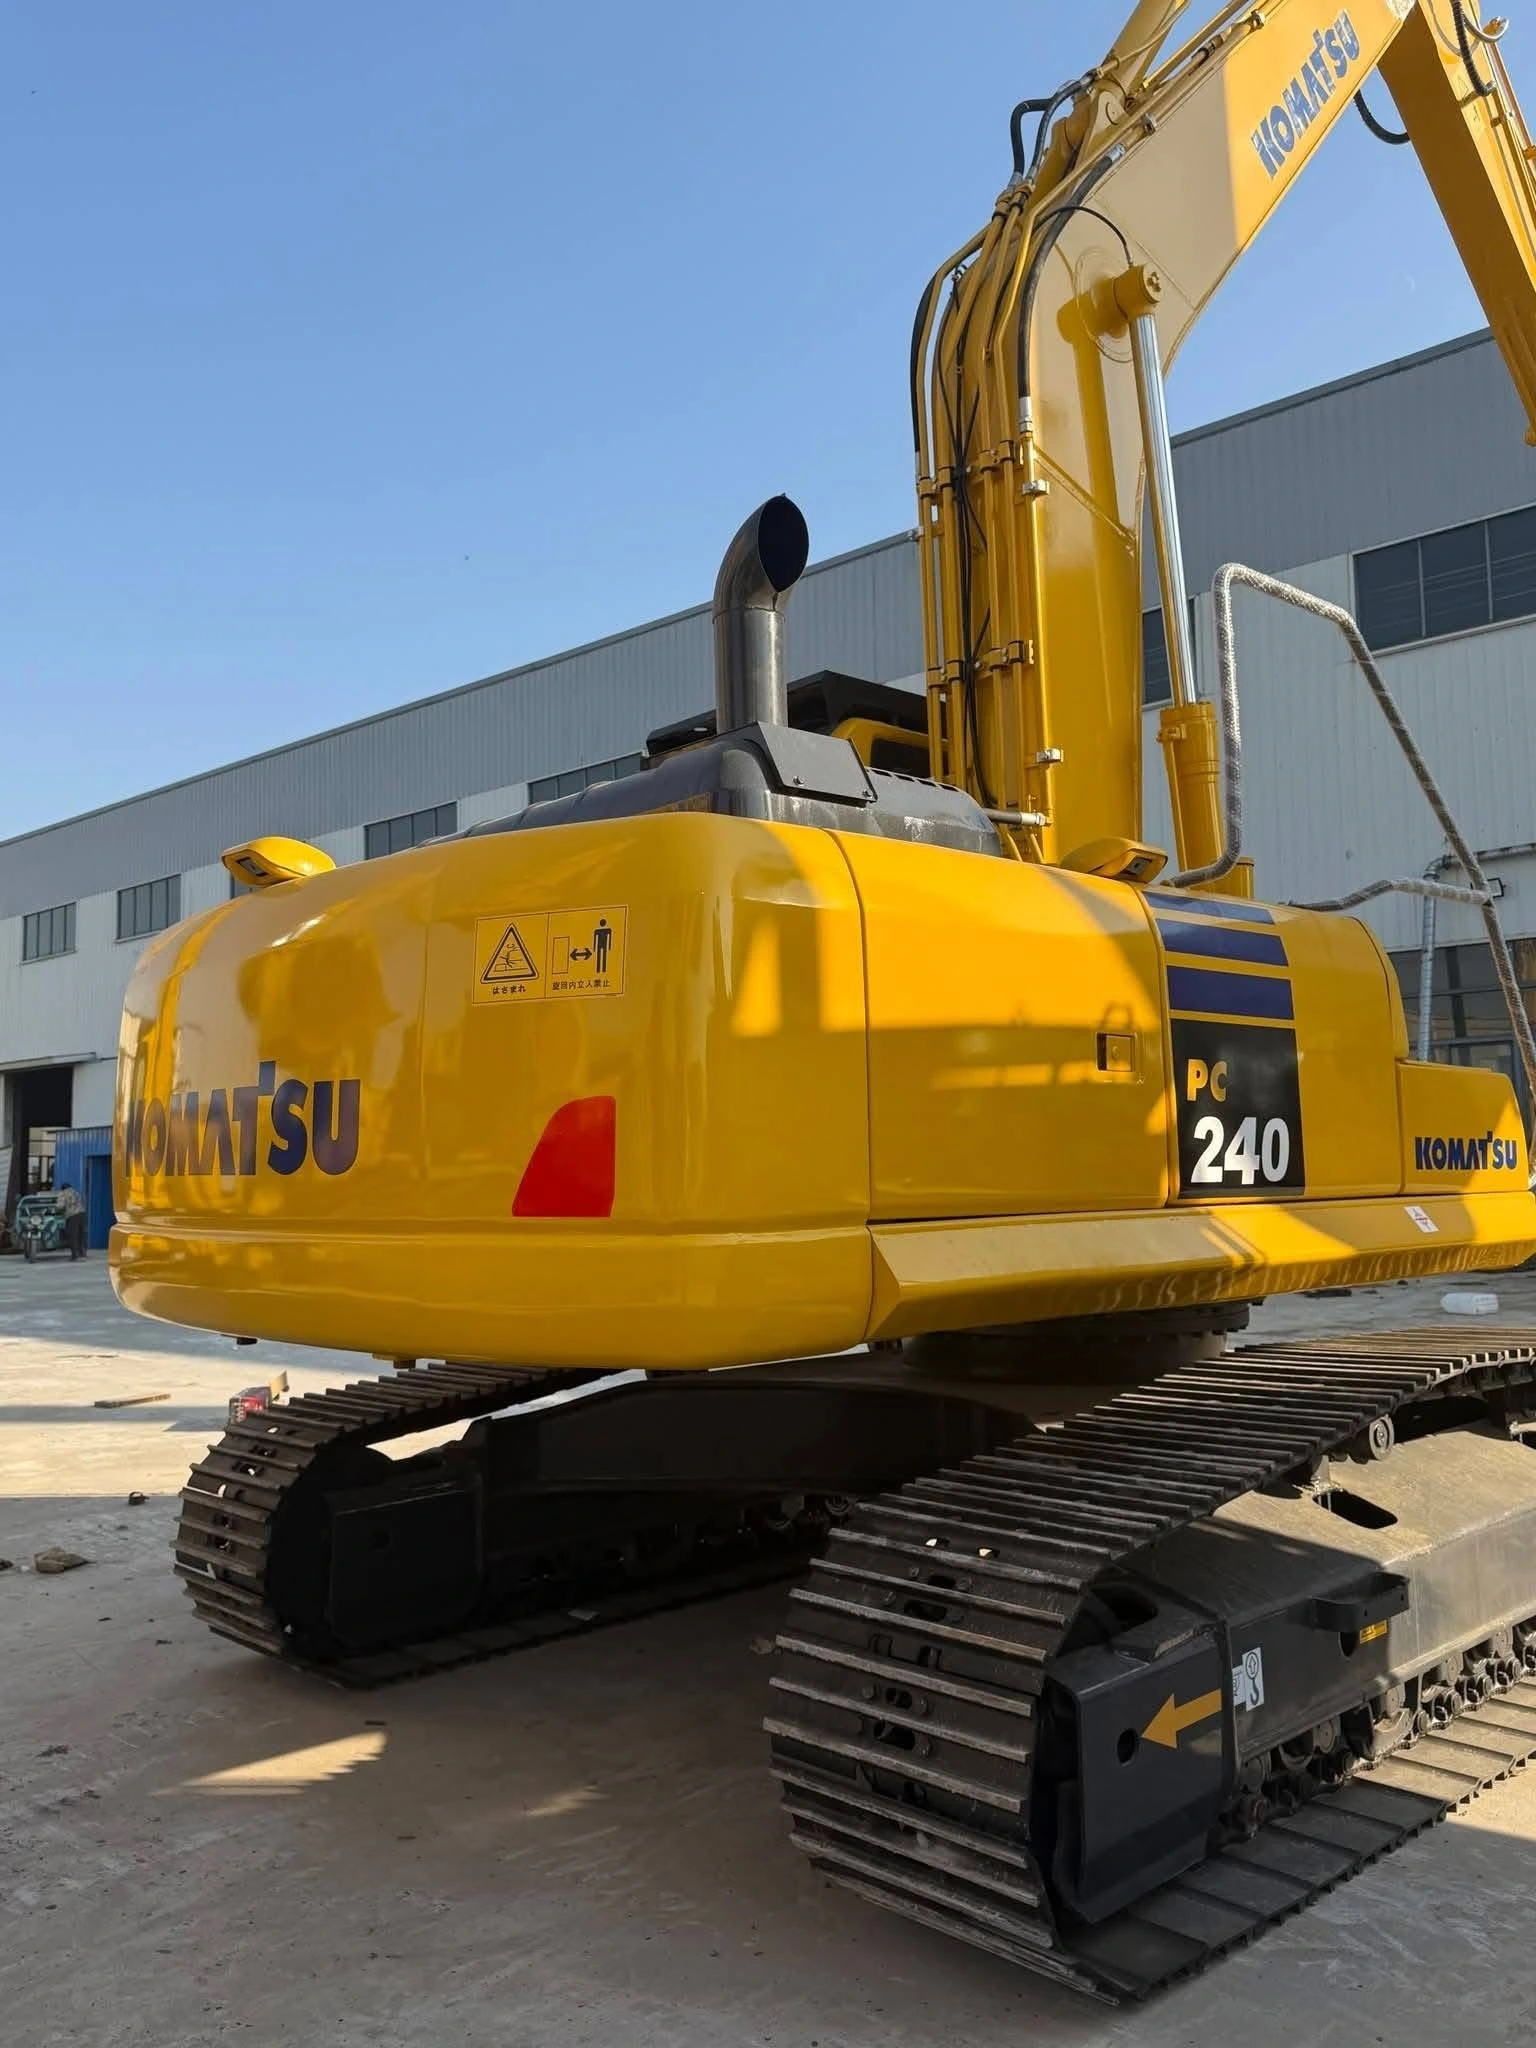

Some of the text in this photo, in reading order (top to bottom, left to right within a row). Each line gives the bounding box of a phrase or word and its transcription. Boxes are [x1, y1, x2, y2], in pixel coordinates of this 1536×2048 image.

[1251, 9, 1360, 178] KOMATSU
[1187, 1058, 1228, 1102] PC
[125, 1060, 361, 1176] KOMATSU
[1190, 1115, 1290, 1185] 240
[1415, 1130, 1517, 1170] KOMATSU
